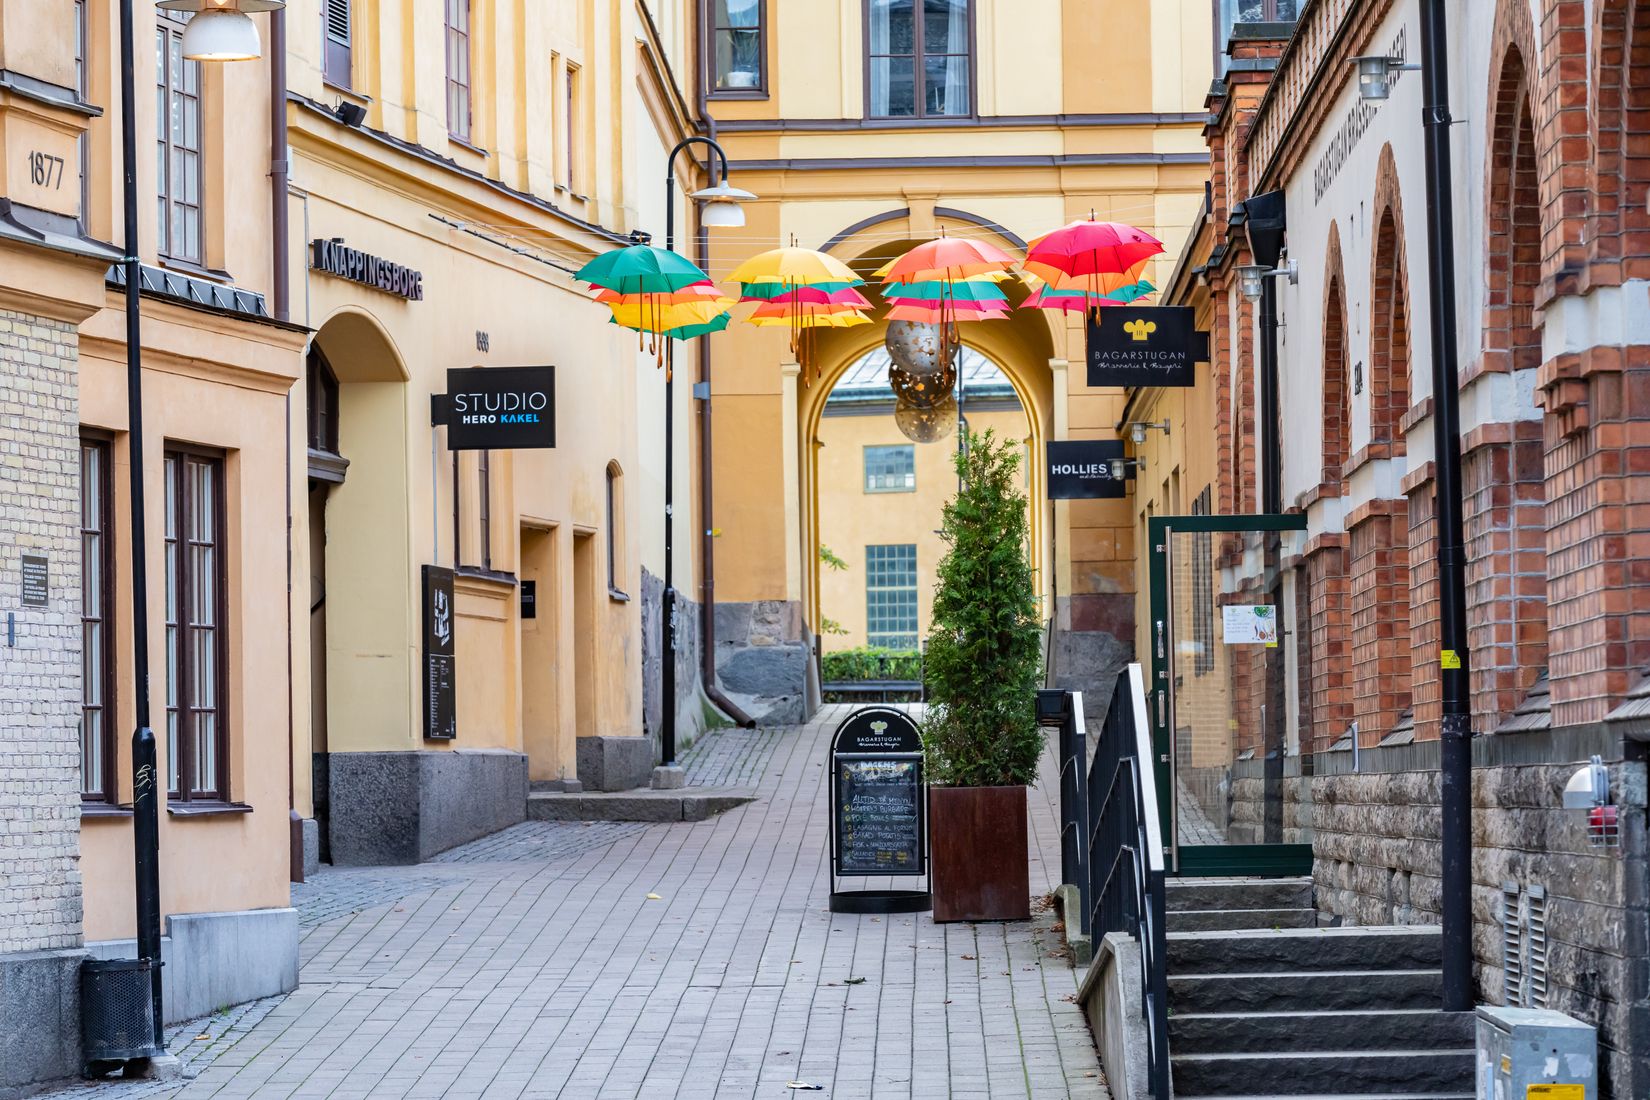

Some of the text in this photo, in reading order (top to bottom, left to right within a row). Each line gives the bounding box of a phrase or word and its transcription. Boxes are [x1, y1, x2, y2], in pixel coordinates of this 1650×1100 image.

[28, 150, 64, 190] 1877
[1094, 351, 1186, 360] BAGARSTUGAN
[454, 392, 547, 412] STUDIO
[462, 413, 540, 424] HERO KAKEL
[1052, 463, 1107, 475] HOLLIES
